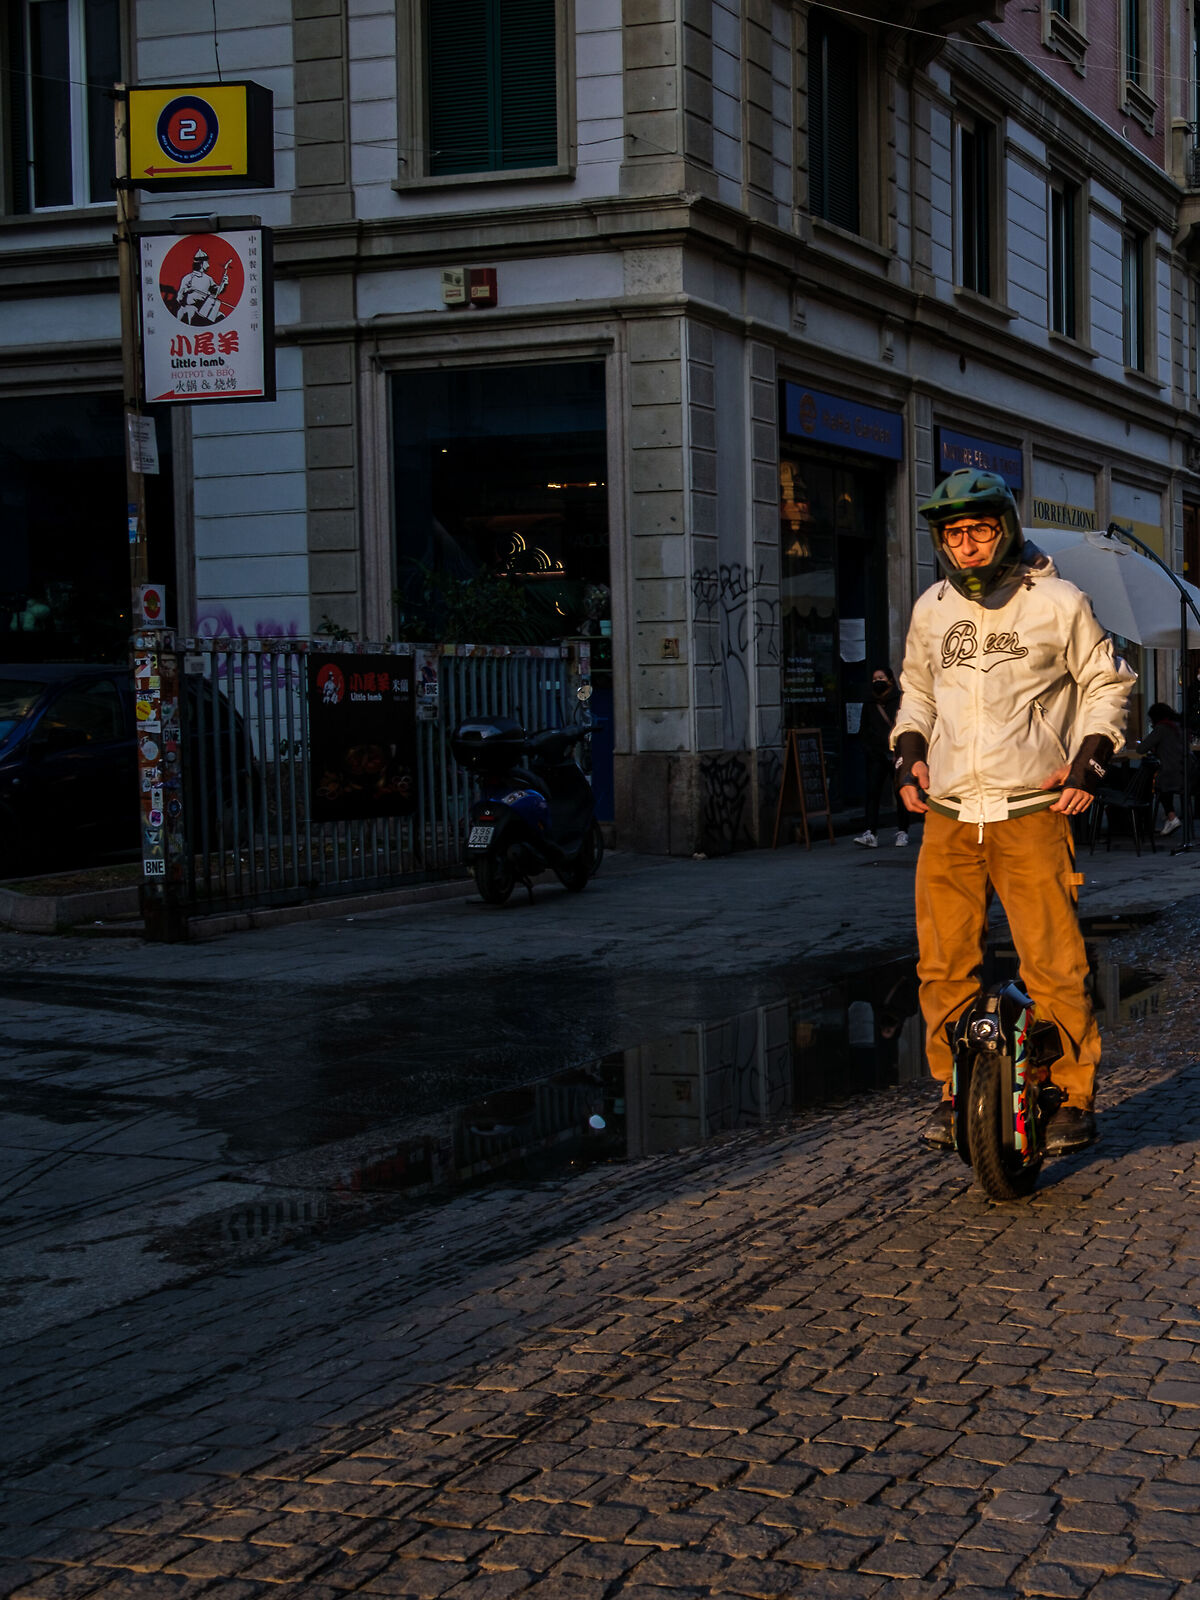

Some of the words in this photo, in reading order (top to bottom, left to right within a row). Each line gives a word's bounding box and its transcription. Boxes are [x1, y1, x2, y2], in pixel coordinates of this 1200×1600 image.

[179, 119, 197, 140] 2
[170, 331, 239, 357] 小尾羊
[171, 358, 197, 369] Little
[199, 357, 225, 367] lamb
[171, 370, 205, 380] HOTPOT
[216, 368, 236, 378] BBQ
[176, 380, 197, 392] 火锅
[201, 380, 211, 390] &
[215, 377, 238, 390] 烧烤
[1032, 499, 1097, 530] TORREFAZIONE
[941, 620, 1028, 670] Bear
[146, 861, 164, 874] BNE
